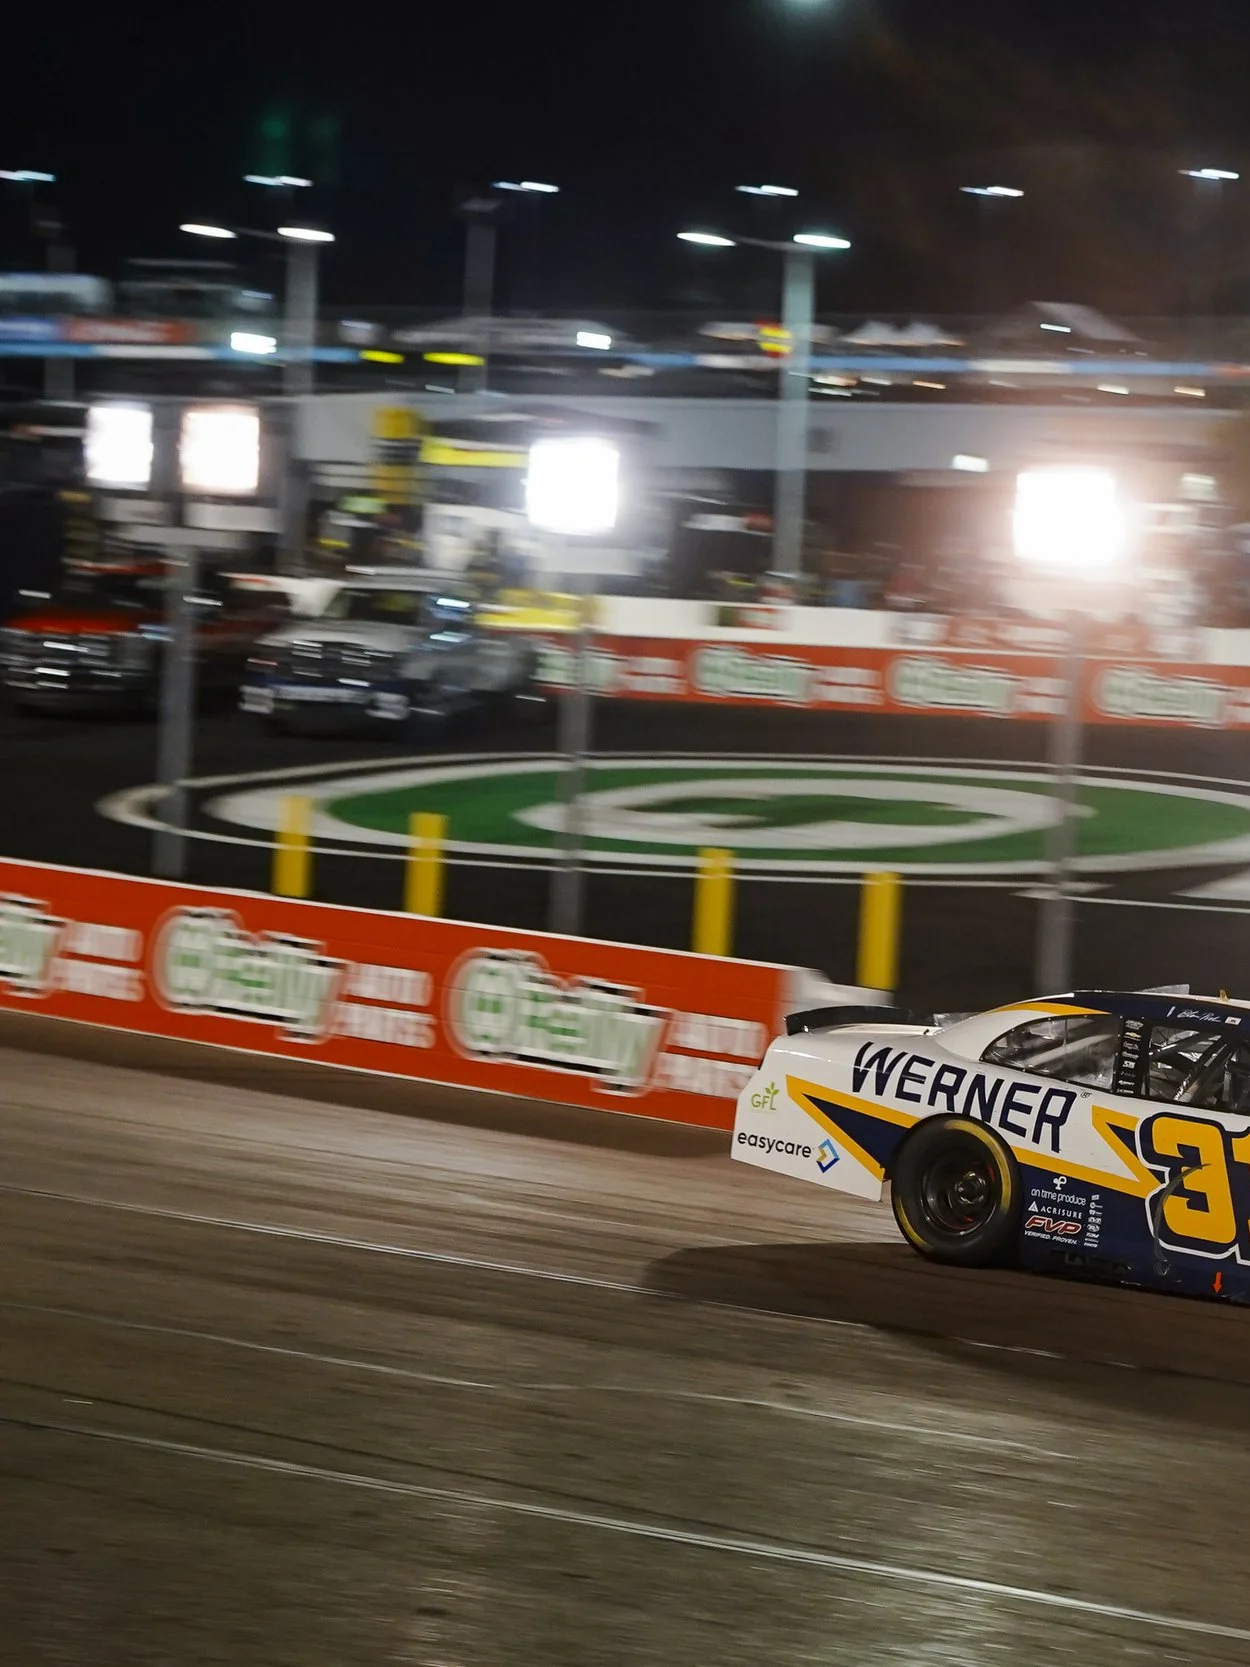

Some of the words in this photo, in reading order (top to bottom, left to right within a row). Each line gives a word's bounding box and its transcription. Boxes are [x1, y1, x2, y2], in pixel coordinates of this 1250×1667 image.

[751, 1087, 778, 1111] GFL
[852, 1042, 1077, 1153] WERNER
[737, 1132, 812, 1158] easycare
[1031, 1188, 1040, 1198] on
[1041, 1189, 1057, 1200] time
[1057, 1194, 1086, 1206] produce
[1041, 1205, 1083, 1220] ACRISURE
[1025, 1215, 1082, 1235] FVP
